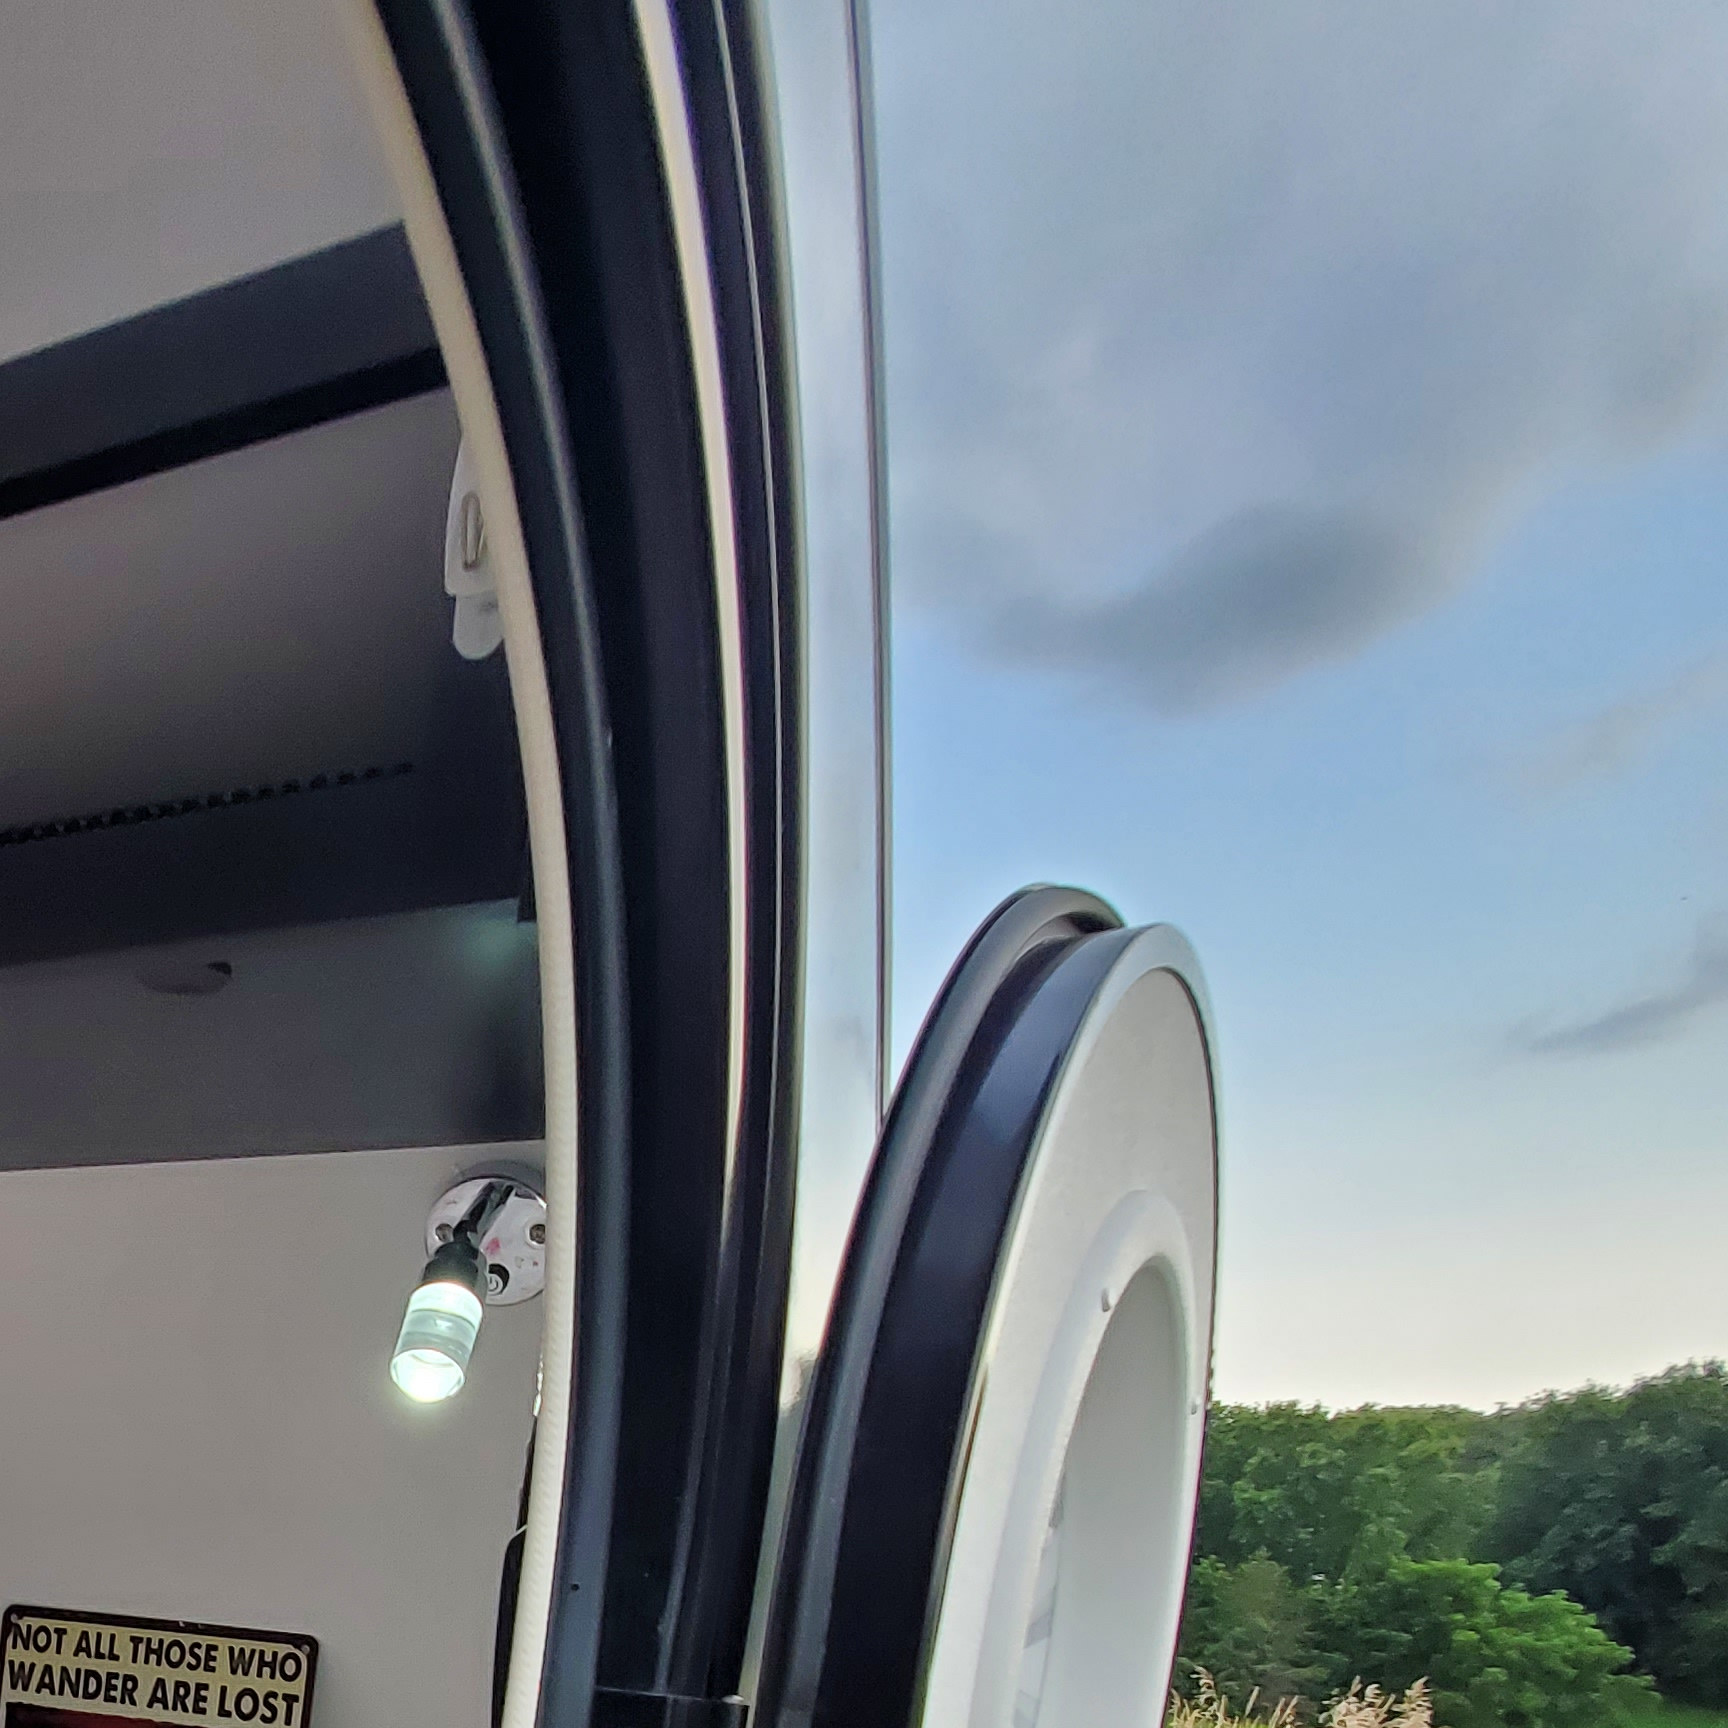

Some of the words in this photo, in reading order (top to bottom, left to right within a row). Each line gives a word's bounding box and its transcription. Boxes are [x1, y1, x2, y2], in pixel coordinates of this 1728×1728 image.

[11, 1623, 68, 1655] NOT
[73, 1630, 120, 1662] ALL
[129, 1635, 219, 1673] THOSE
[228, 1645, 302, 1682] WHO
[8, 1659, 139, 1707] WANDER
[146, 1677, 210, 1716] ARE
[217, 1685, 300, 1727] LOST
